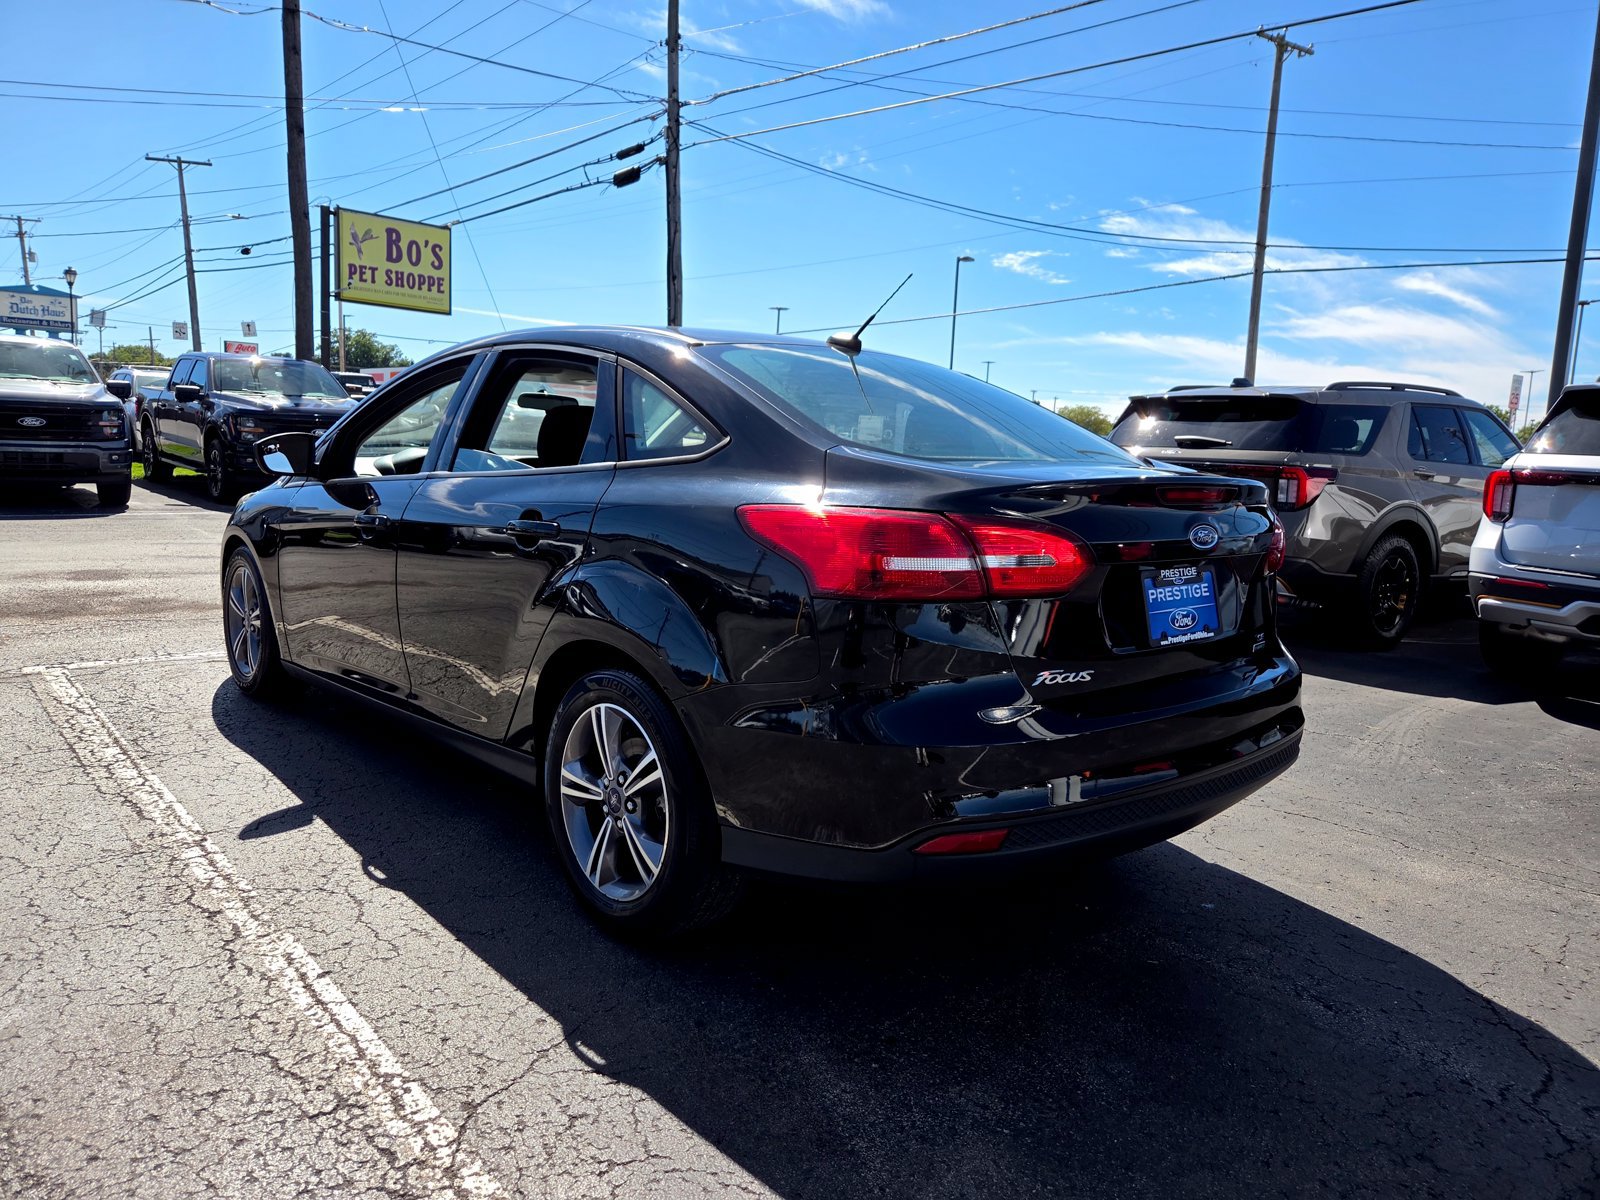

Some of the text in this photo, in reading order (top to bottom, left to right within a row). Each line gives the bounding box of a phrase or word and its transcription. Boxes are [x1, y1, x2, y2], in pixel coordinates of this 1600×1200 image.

[347, 263, 379, 284] PET
[384, 269, 445, 294] SHOPPE
[9, 302, 66, 317] Dutch Haus
[2, 316, 40, 326] Restaurant
[233, 343, 257, 353] Auto
[1160, 566, 1198, 579] PRESTIGE
[1148, 583, 1210, 603] PRESTIGE
[1174, 611, 1193, 627] Ford
